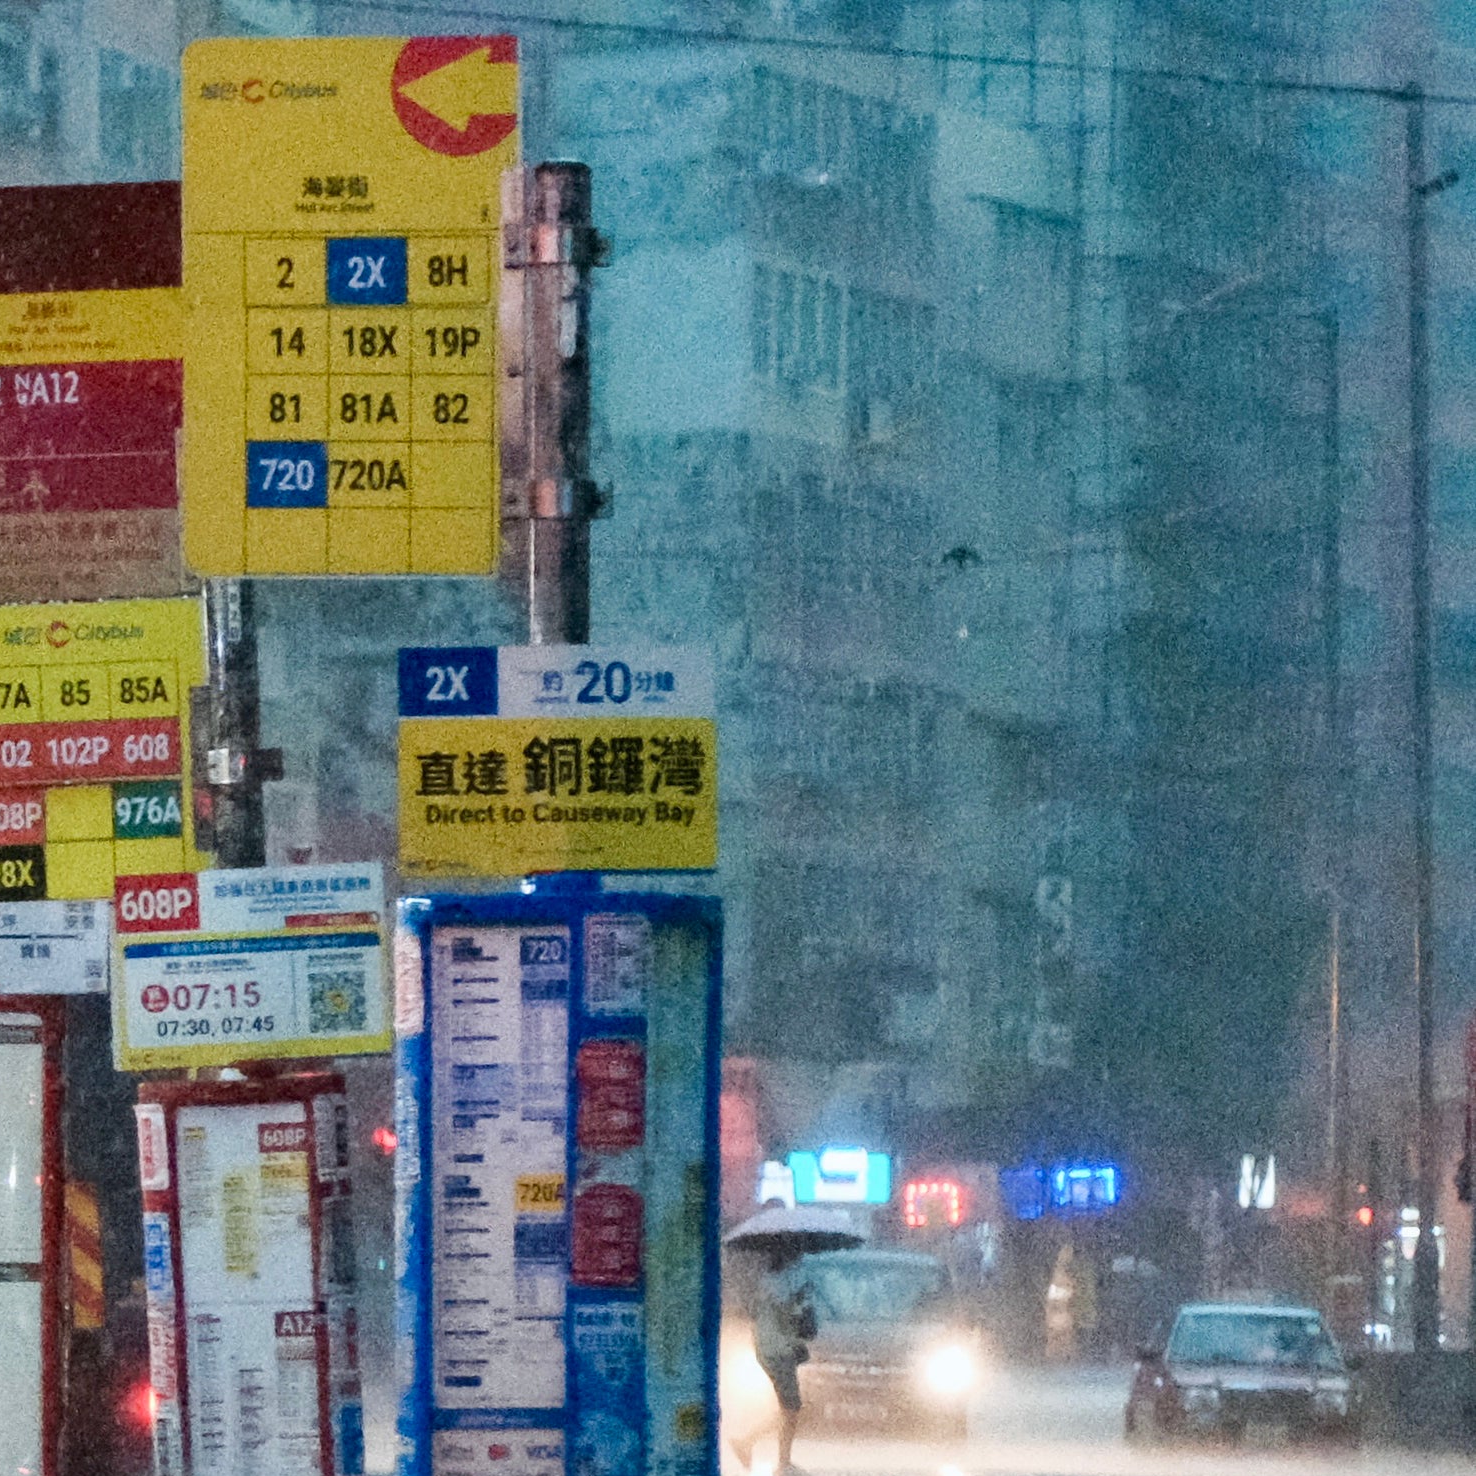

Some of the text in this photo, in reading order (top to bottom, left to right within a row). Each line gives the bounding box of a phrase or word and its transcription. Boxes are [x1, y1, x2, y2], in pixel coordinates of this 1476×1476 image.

[277, 256, 468, 289] 2 2X 8H
[271, 327, 480, 358] 14 18X 19P
[269, 393, 469, 424] 81 81A 82
[259, 459, 407, 491] 720 720A
[60, 680, 91, 707] 85
[120, 676, 170, 703] 85A
[426, 666, 470, 700] 2X
[576, 661, 631, 704] 20
[48, 737, 108, 765] 102P
[123, 734, 169, 763] 608
[416, 736, 706, 796] 直達 銅鑼灣
[116, 797, 181, 824] 976A
[426, 802, 695, 826] Direct to Causeway Bay
[121, 888, 192, 921] 608P
[529, 938, 561, 959] 720
[173, 981, 261, 1011] 07:15
[222, 1015, 274, 1034] 07:45
